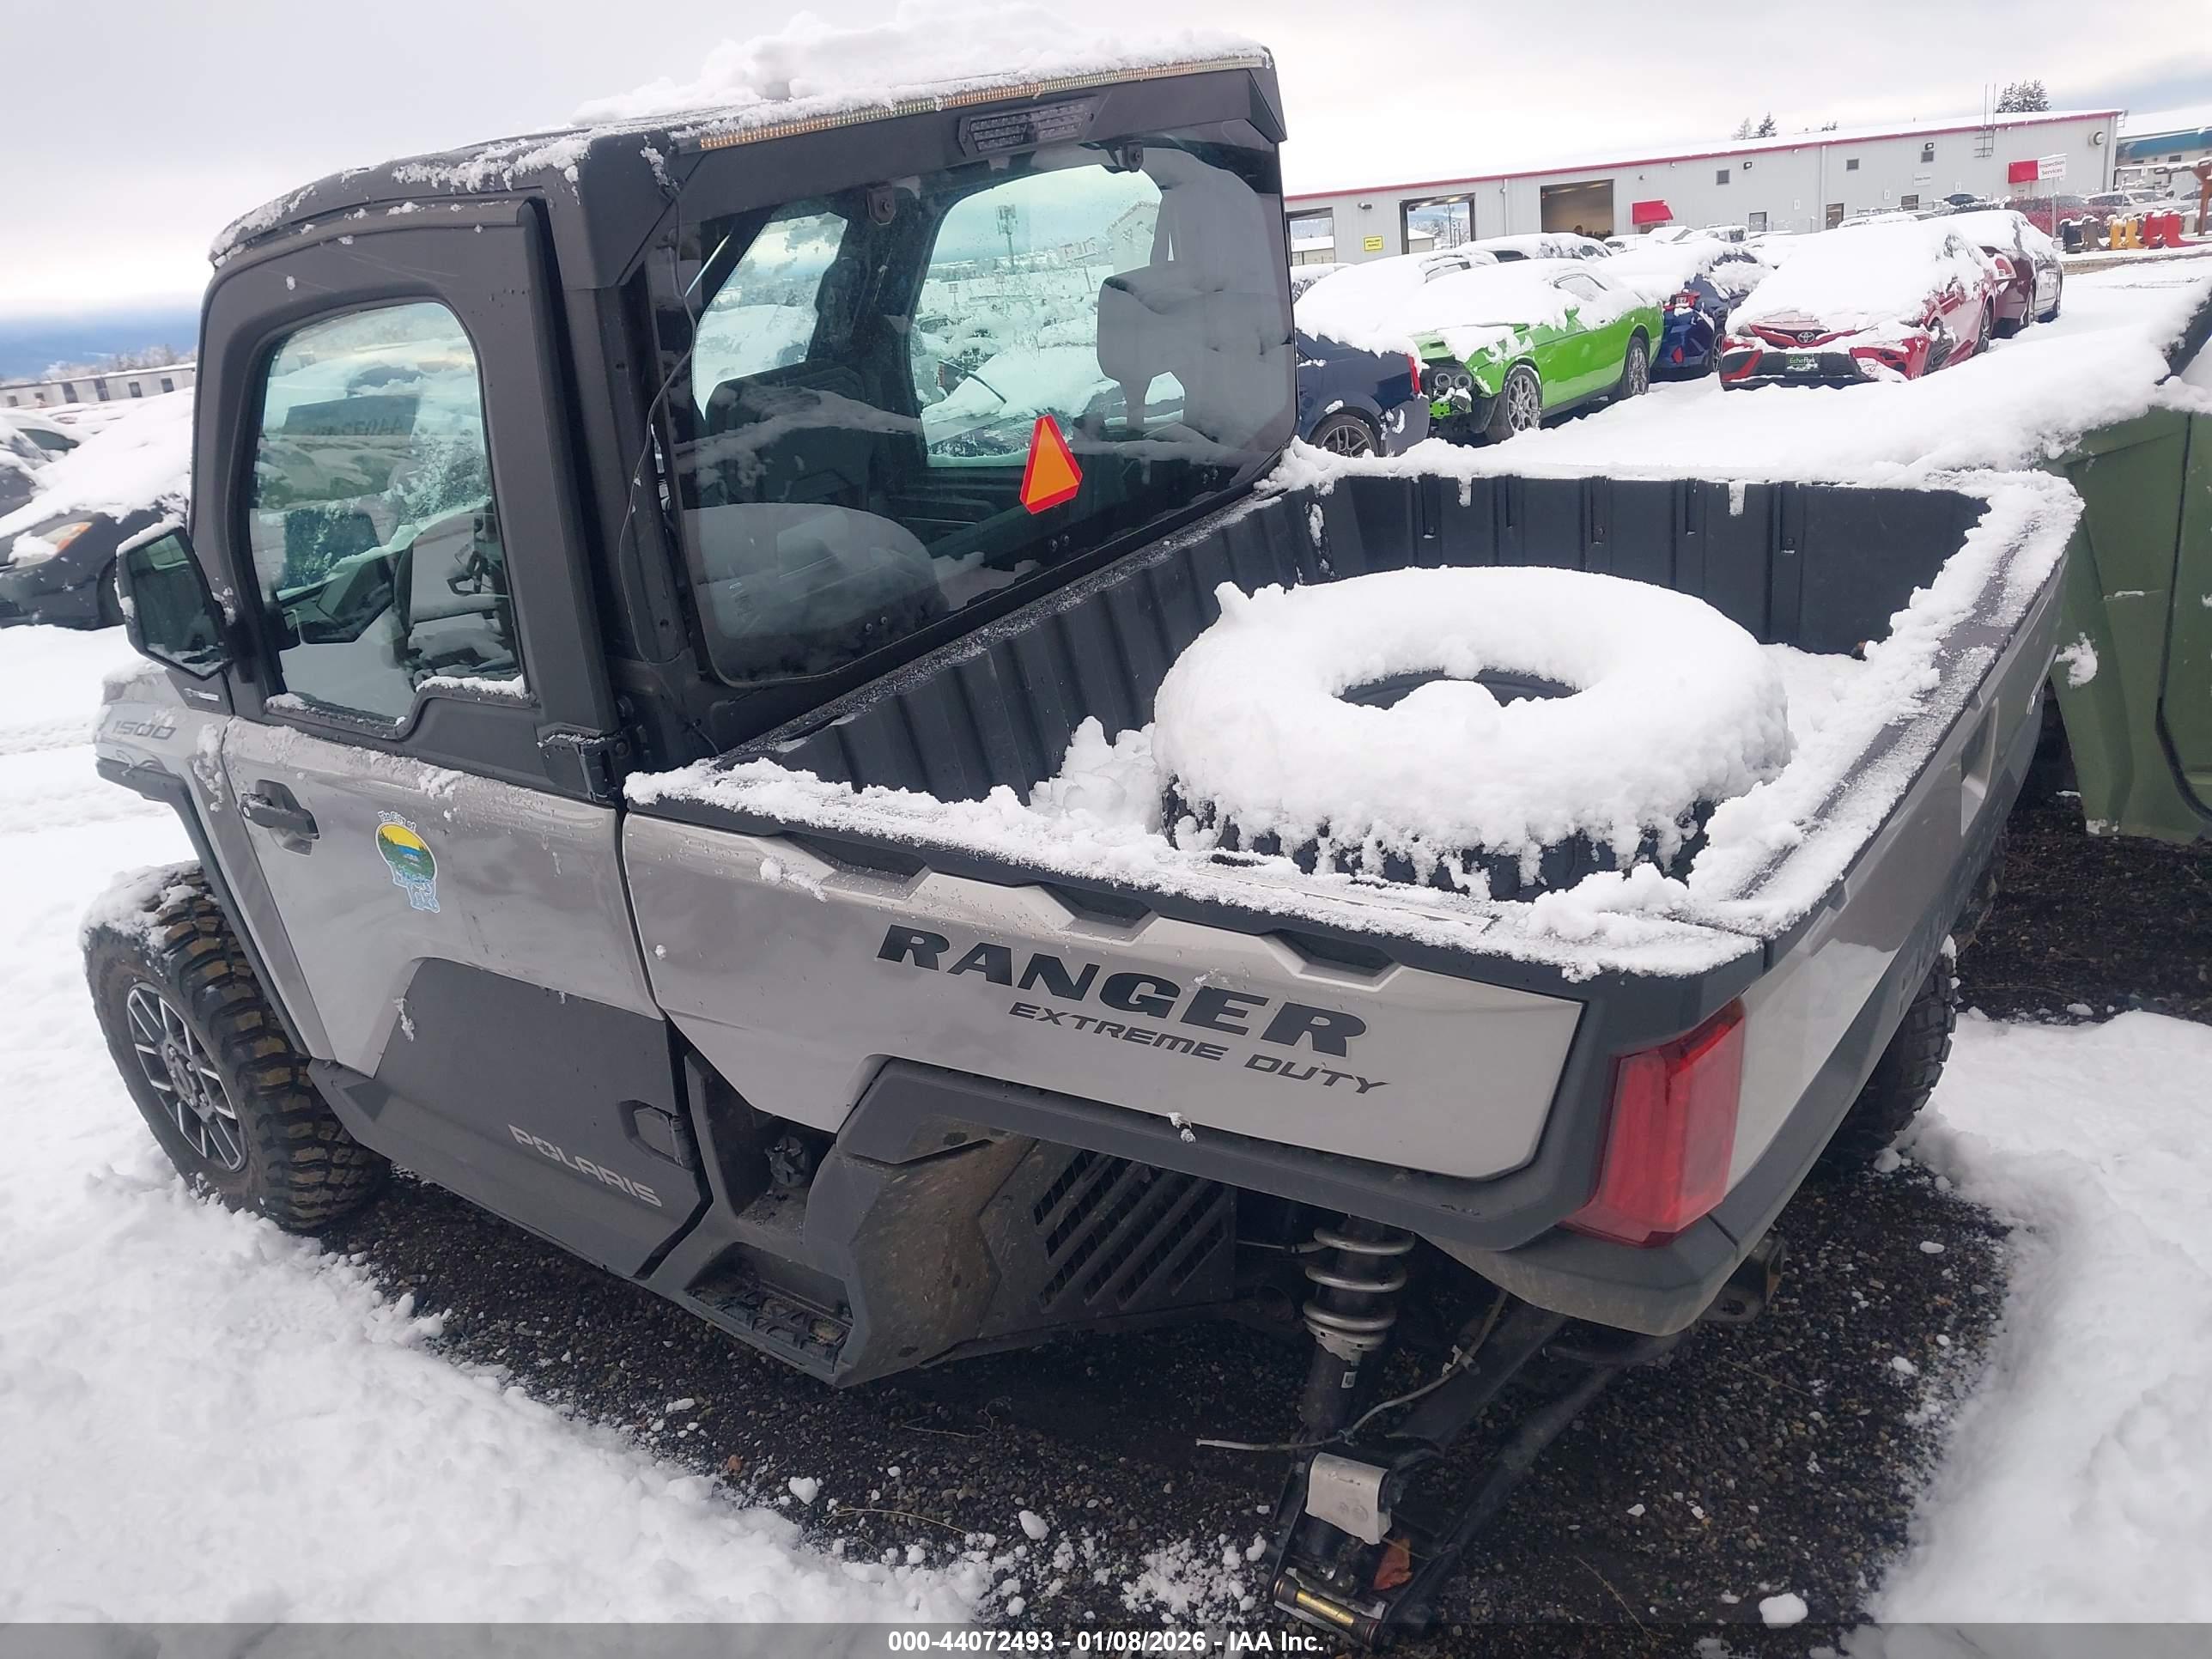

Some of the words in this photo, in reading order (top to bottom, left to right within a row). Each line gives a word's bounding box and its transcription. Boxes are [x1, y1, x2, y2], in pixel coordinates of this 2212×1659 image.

[113, 720, 177, 740] 1500
[877, 924, 1367, 1058] RANGER
[1009, 1001, 1230, 1061] EXTREME
[1244, 1054, 1389, 1094] DUTY
[507, 1123, 663, 1207] POLARIS
